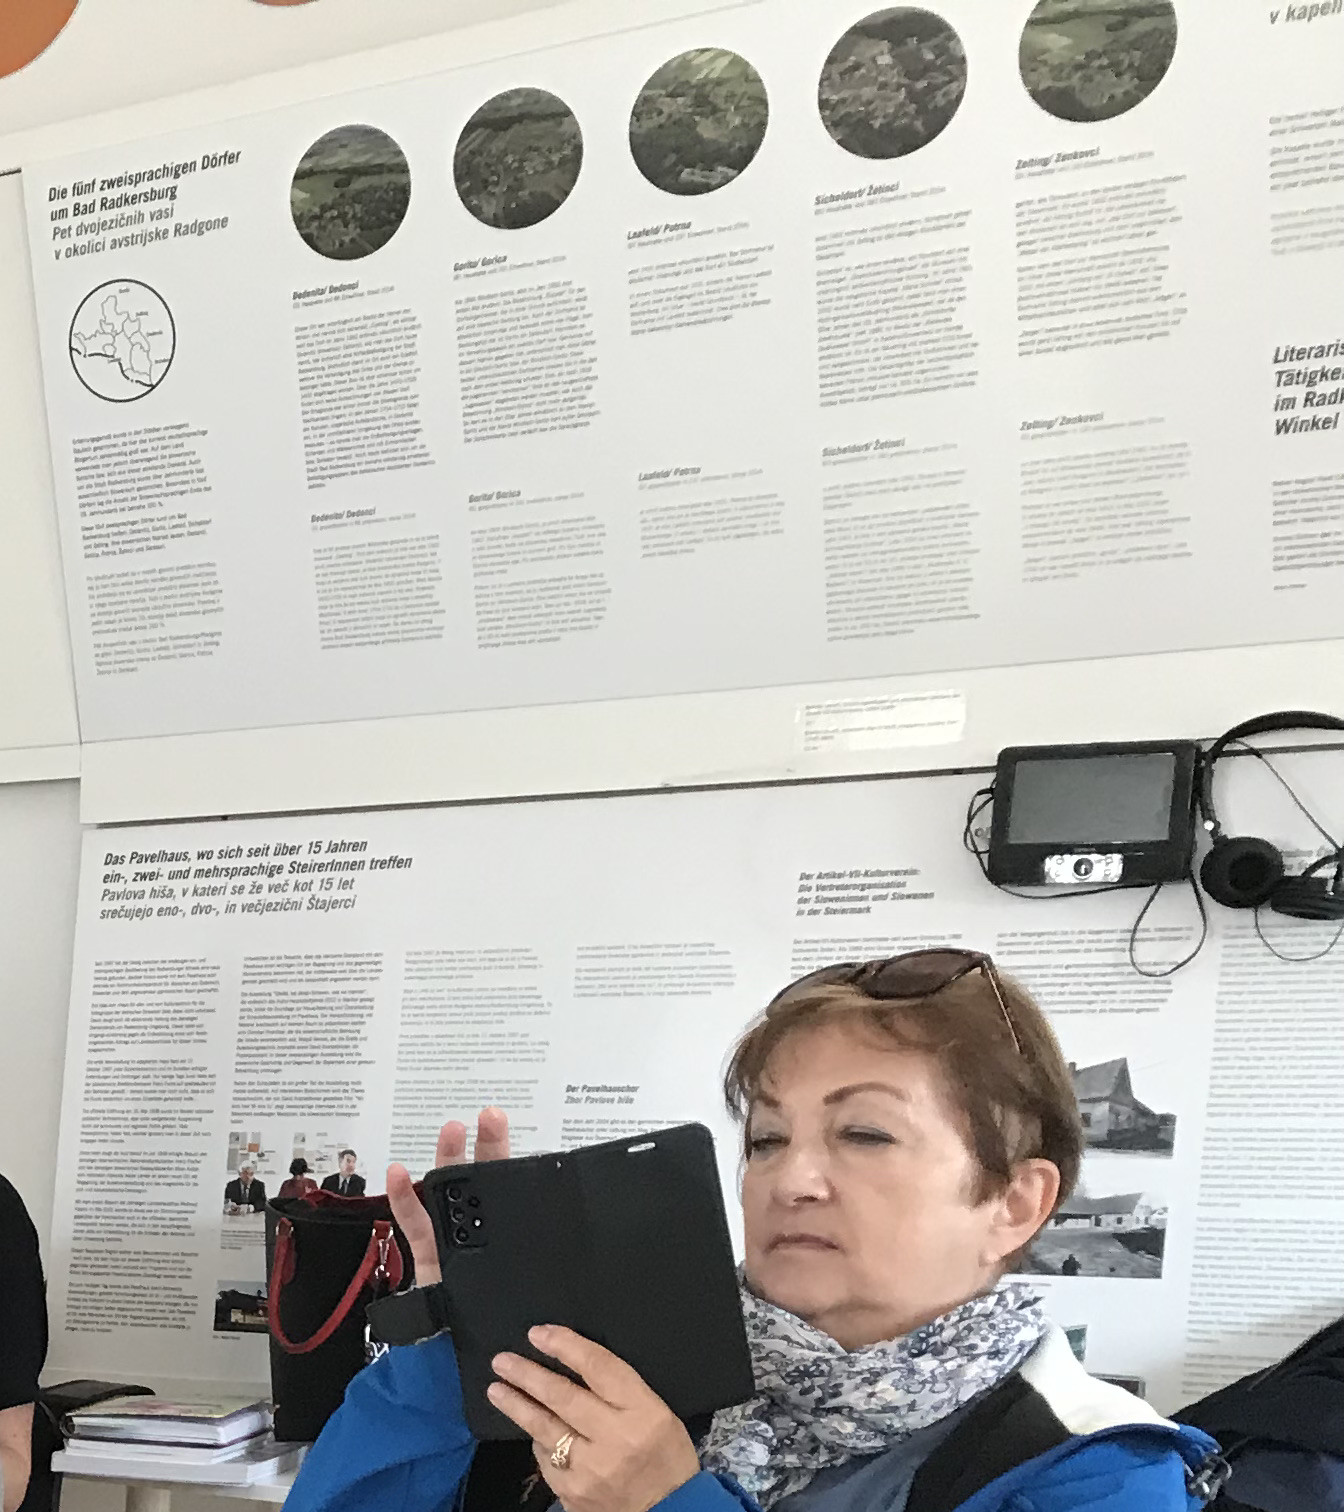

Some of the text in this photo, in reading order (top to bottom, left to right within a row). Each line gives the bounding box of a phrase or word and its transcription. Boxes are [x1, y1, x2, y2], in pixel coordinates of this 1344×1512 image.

[1271, 10, 1280, 24] v
[48, 150, 242, 202] Die fünf zweisprachigen Dörfer
[51, 185, 178, 221] um Bad Radkersburg
[52, 203, 174, 241] Pet dvojezičnih vasi
[55, 216, 229, 260] v okolici avstrijske Radgone
[1274, 394, 1297, 411] im
[1275, 412, 1340, 436] Winkel
[104, 839, 367, 866] Das Pavelhaus, wo sich seit über 15 Jahren
[103, 855, 413, 884] ein-, zwei- und mehrsprachige SteirerInnen treffen
[101, 877, 355, 902] Pavlova hiša, v kateri se že več kot 15 let
[872, 893, 889, 901] und
[100, 894, 357, 921] srečujejo eno-, dvo-, in večjezični Štajerci
[807, 908, 821, 916] der
